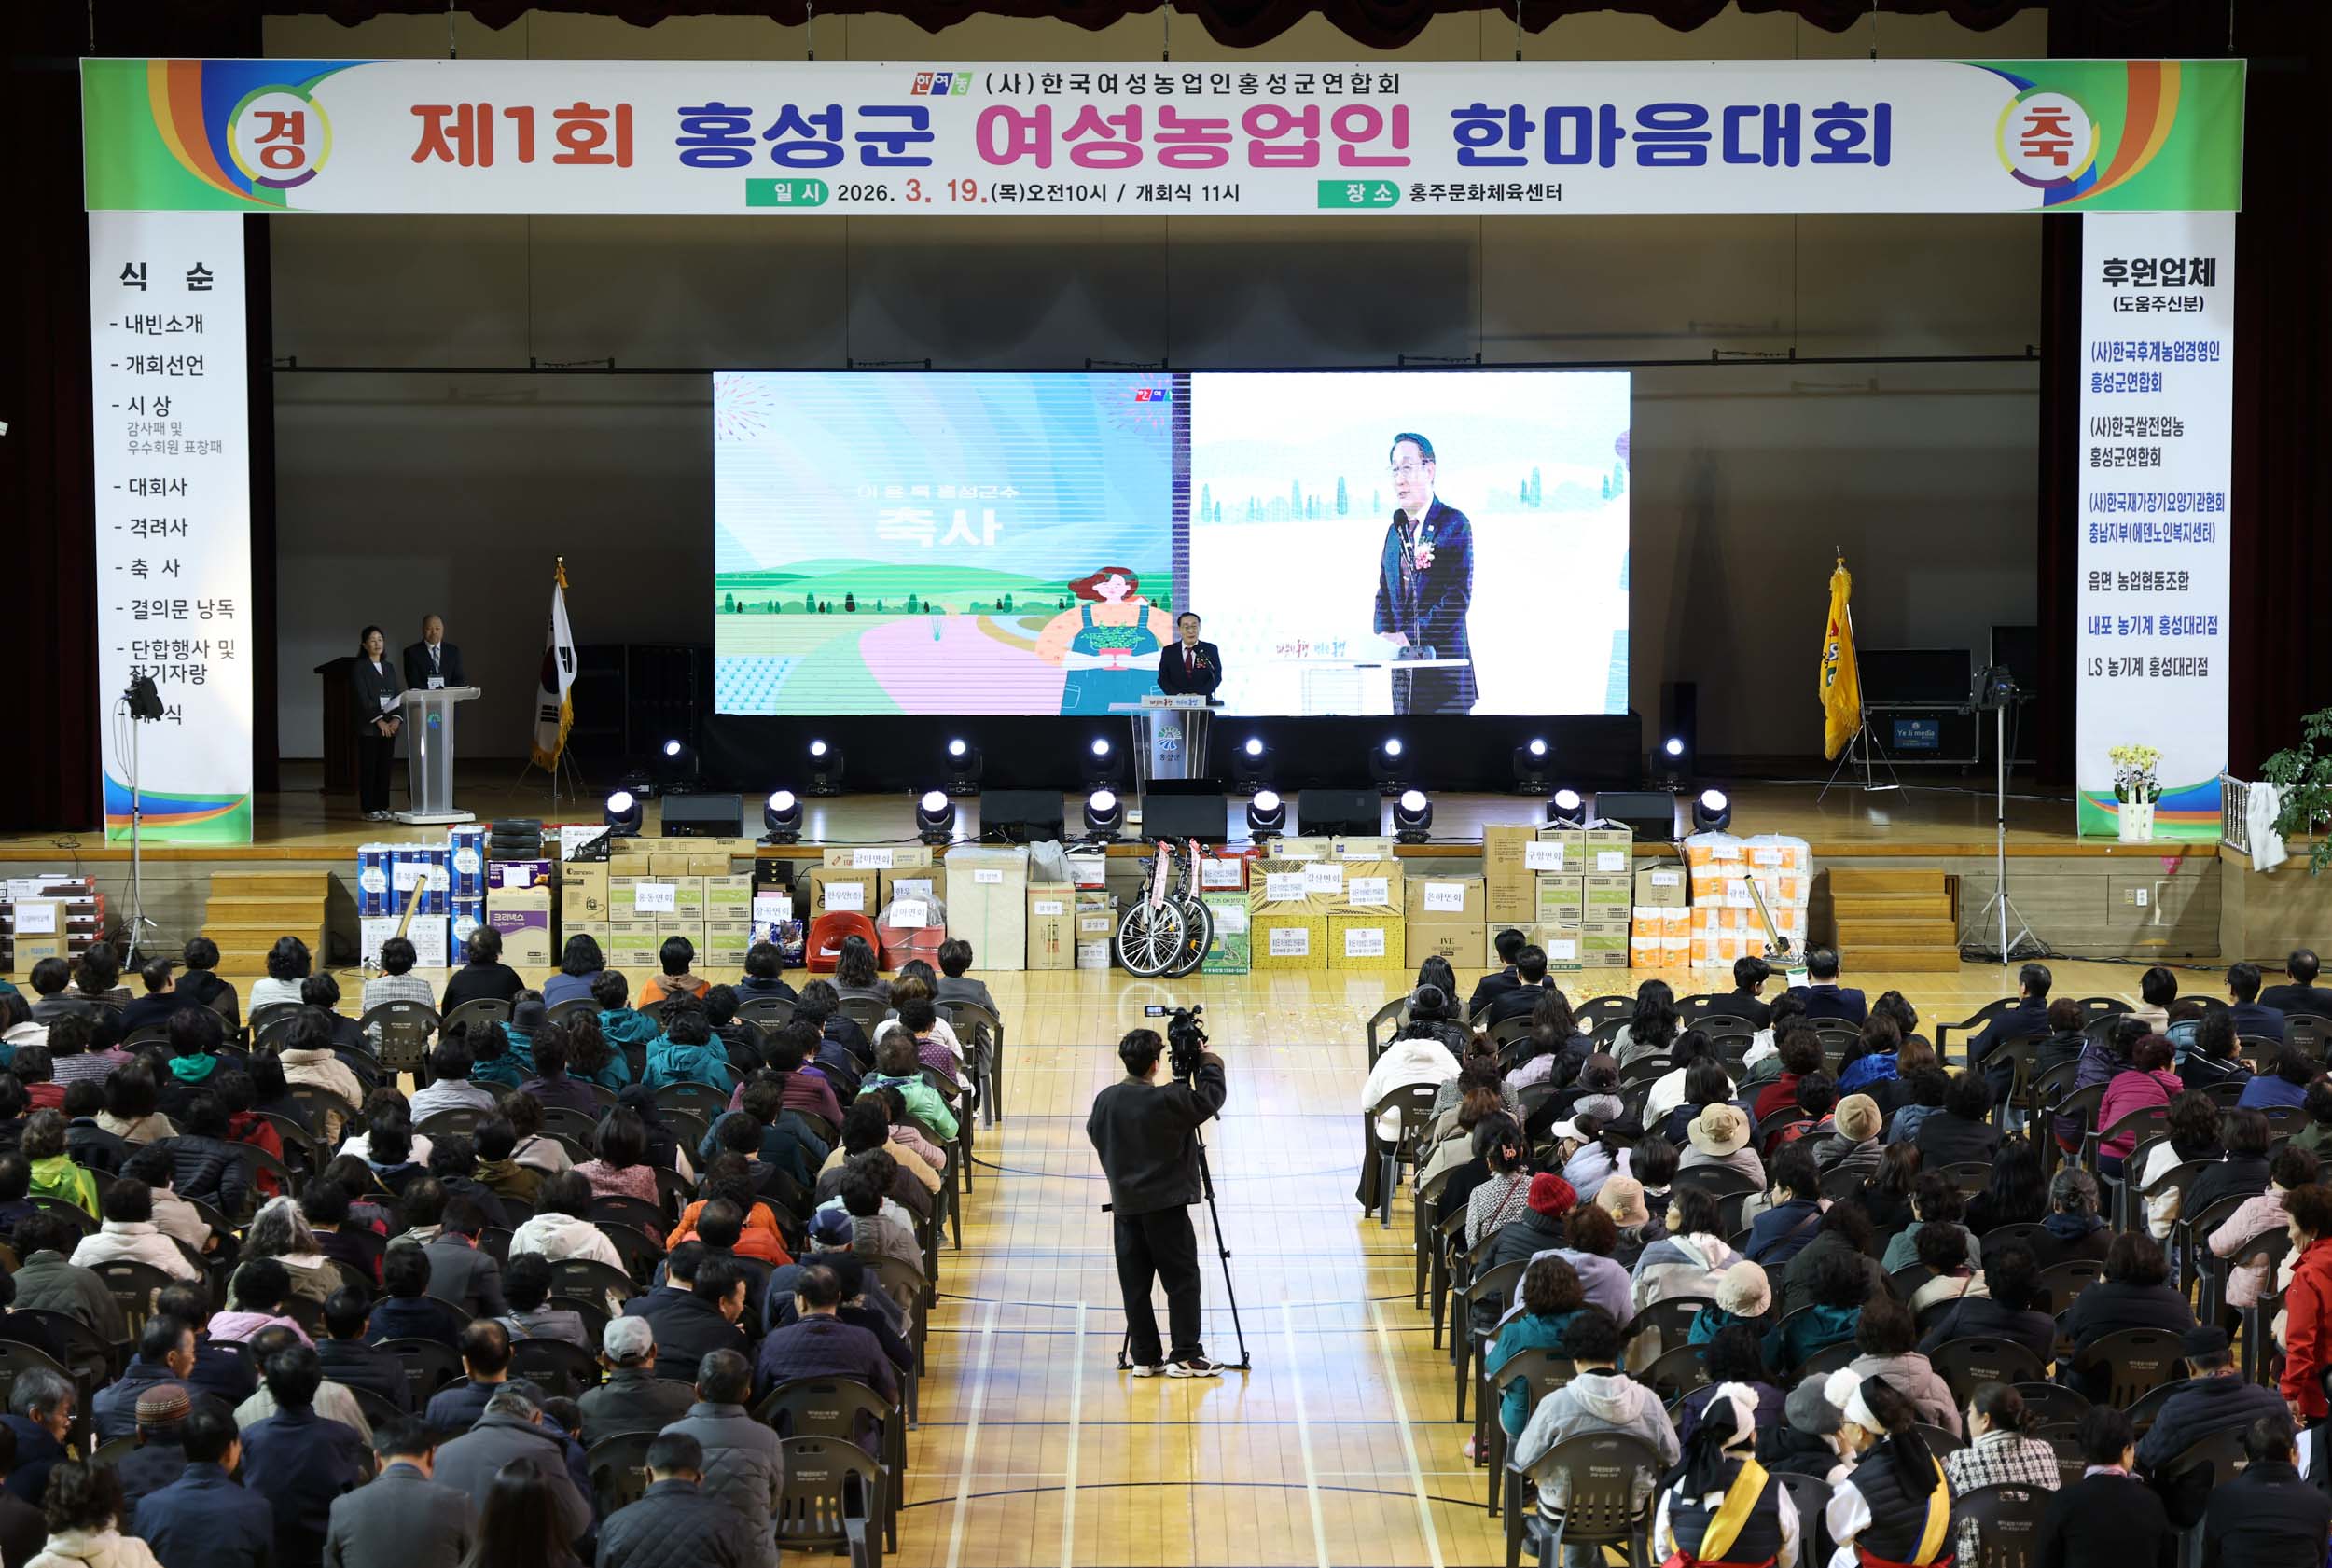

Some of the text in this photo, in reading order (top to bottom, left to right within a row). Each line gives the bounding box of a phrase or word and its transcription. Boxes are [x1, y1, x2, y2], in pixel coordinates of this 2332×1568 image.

[251, 111, 309, 172] 경
[410, 101, 1891, 169] 제1회 홍성군 여성농업인 한마음대회
[2020, 107, 2074, 166] 축
[838, 185, 895, 201] 2026.
[906, 179, 931, 202] 3.
[1136, 184, 1190, 202] 개회식
[1202, 184, 1239, 202] 11시
[1409, 183, 1562, 202] 홍주문화체육센터
[2103, 257, 2216, 287] 후원업체
[2114, 296, 2204, 312] (도움주신분)
[126, 314, 202, 335] 내빈소개
[2092, 341, 2219, 362] (사)한국후계농업경영인
[127, 355, 203, 376] 개회선언
[2091, 372, 2161, 393] 홍성군연합회
[128, 423, 181, 437] 감사패 및
[2091, 416, 2184, 437] (사)한국쌀전업농
[128, 440, 221, 455] 우수회원 표창패
[2090, 447, 2160, 467] 홍성군연합회
[130, 478, 187, 497] 대회사
[2090, 493, 2224, 512] (사)한국재가장기요양기관협회
[131, 518, 187, 539] 격려사
[876, 507, 1004, 548] 축사
[2089, 571, 2189, 591] 읍면 농업협동조합
[132, 599, 234, 619] 결의문 낭독
[2089, 615, 2217, 635] 내포 농기계 홍성대리점
[132, 639, 234, 660] 단합행사 및
[2089, 657, 2208, 677] LS 농기계 홍성대리점
